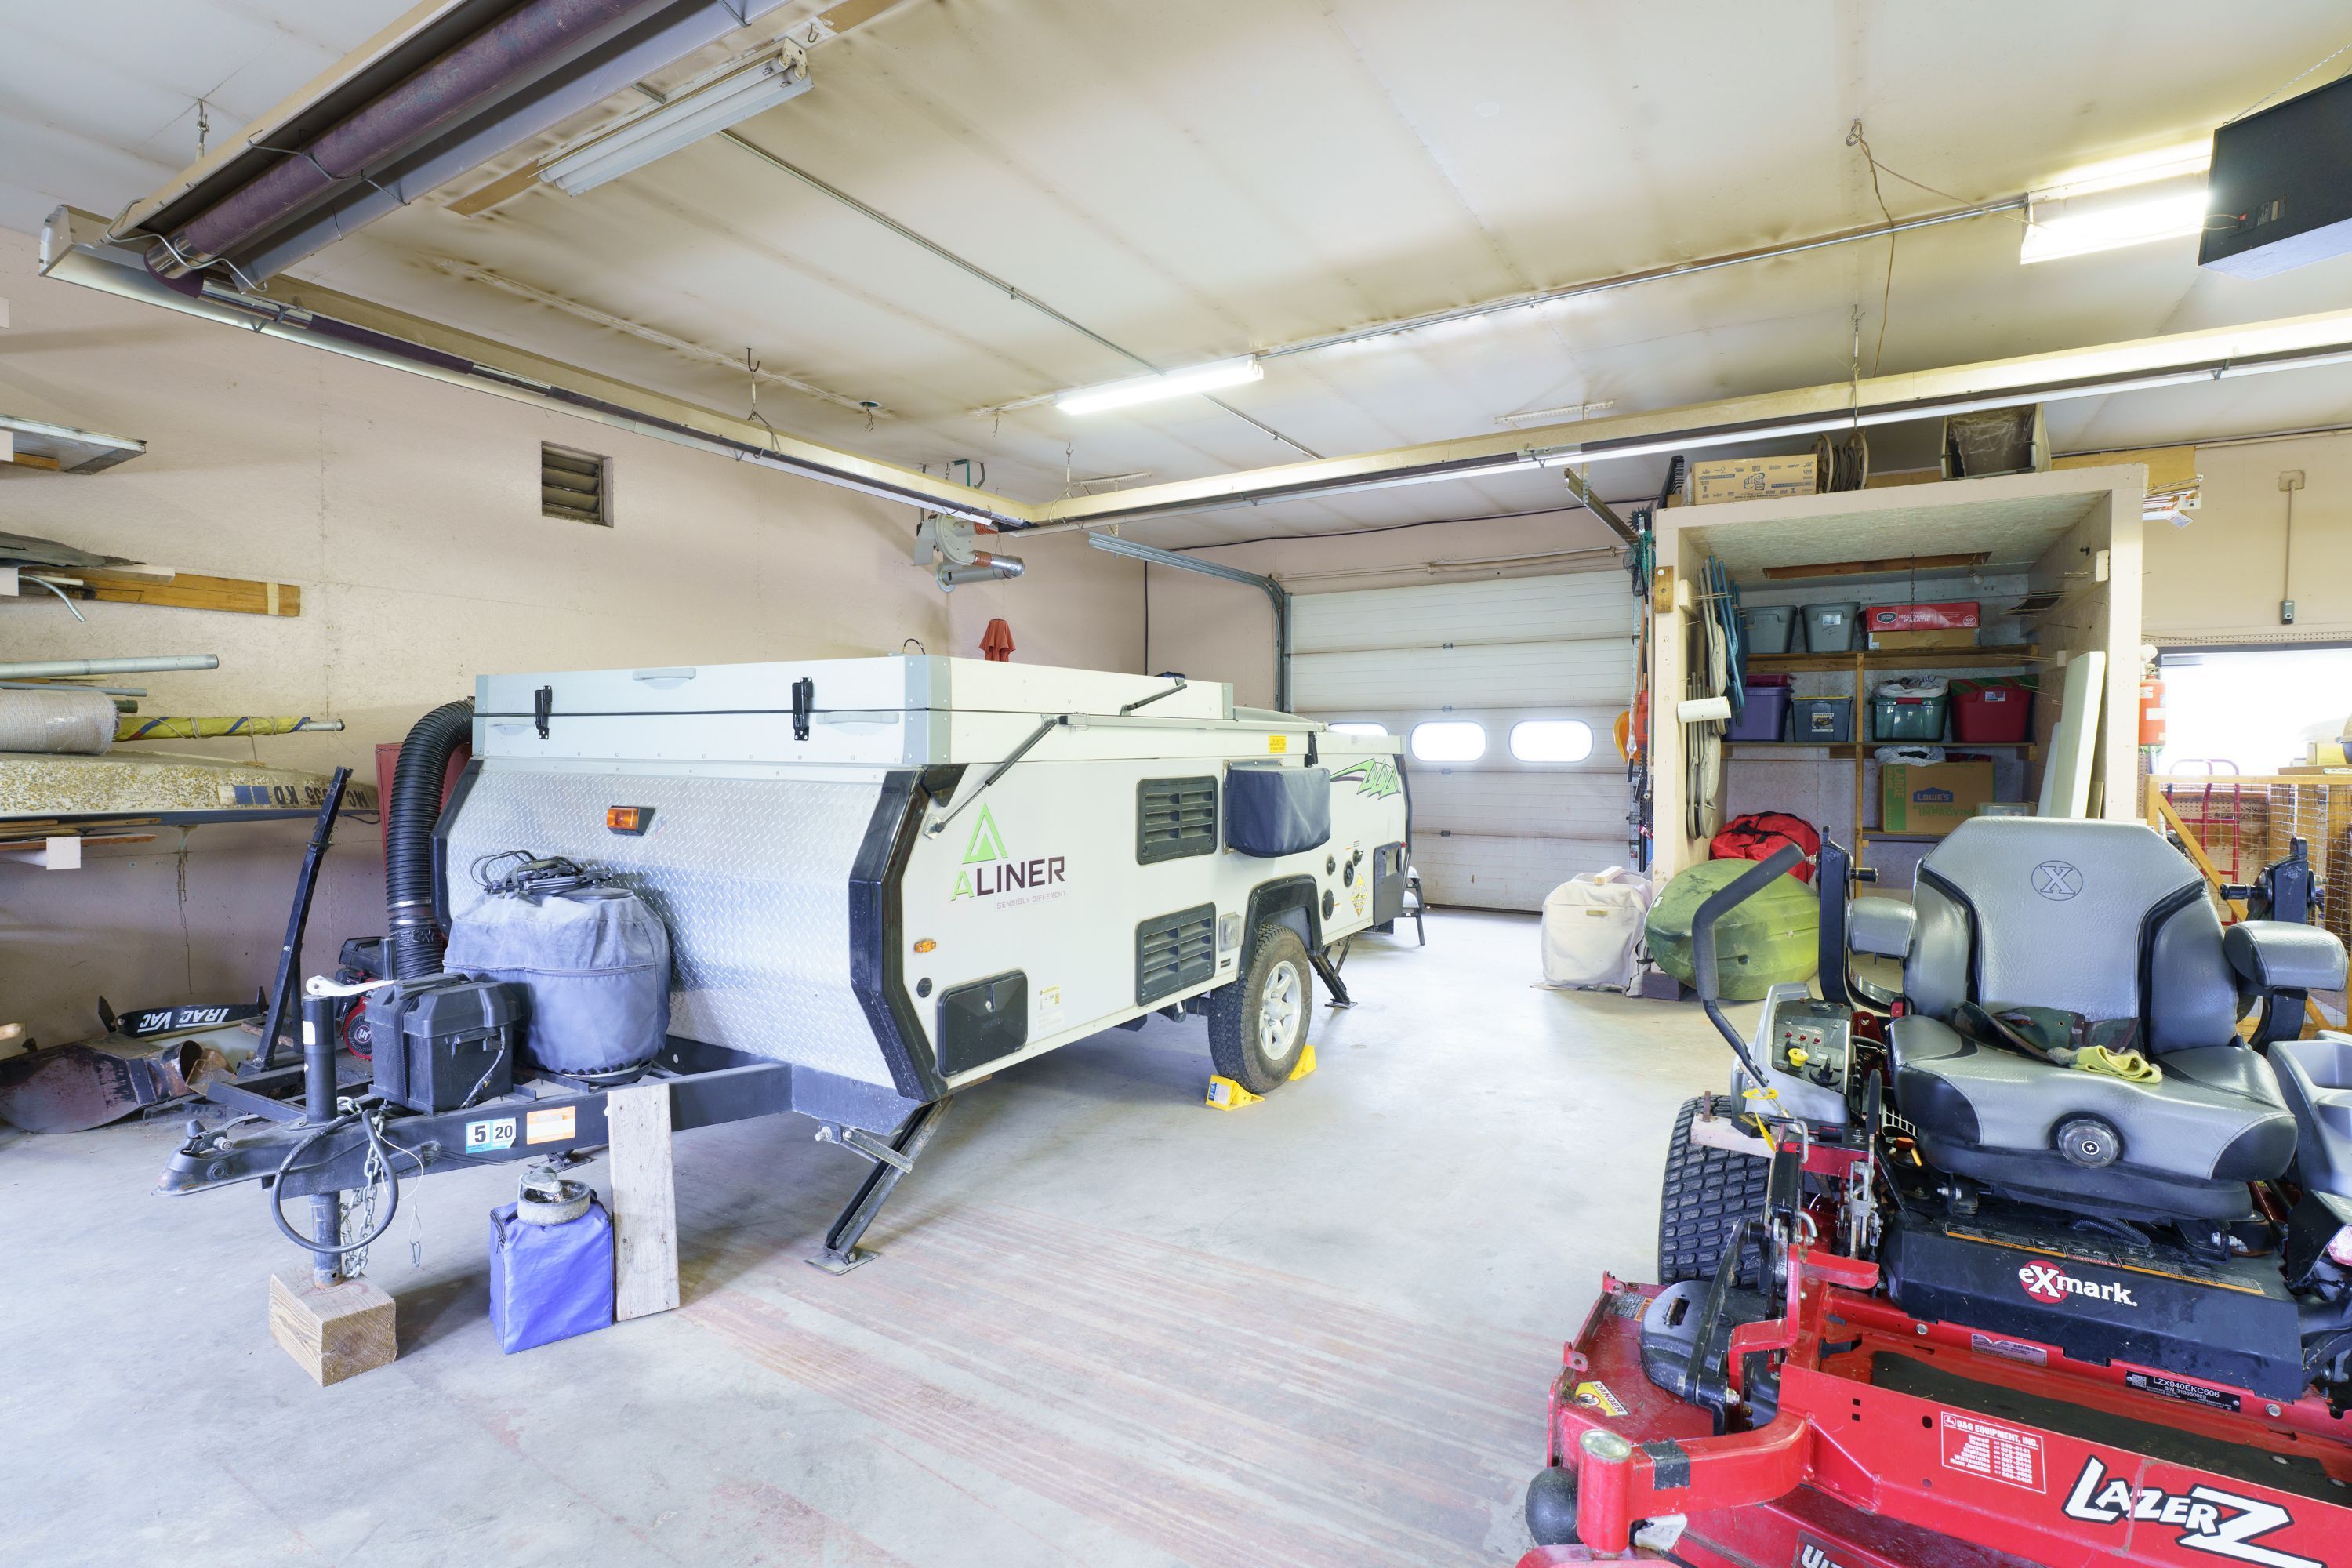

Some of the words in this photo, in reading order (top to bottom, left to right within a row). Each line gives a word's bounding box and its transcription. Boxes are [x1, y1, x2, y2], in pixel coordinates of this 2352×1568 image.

[1894, 766, 1904, 798] LARGE
[274, 785, 299, 805] KD
[348, 789, 370, 807] MC
[1918, 793, 1949, 801] LOWE'S
[951, 856, 1065, 901] ALINER
[996, 897, 1030, 909] SENSIBLY
[1033, 890, 1067, 902] DIFFERENT
[137, 1011, 172, 1033] VAC
[175, 1008, 230, 1028] TRAC
[474, 1125, 486, 1143] 5
[495, 1125, 513, 1139] 20
[1595, 1383, 1624, 1413] DANGER
[2153, 1377, 2220, 1398] LZX940EKC606
[1956, 1420, 1973, 1431] D&G
[1975, 1424, 2020, 1444] EQUIPMENT,
[2022, 1436, 2039, 1448] INC.
[2064, 1456, 2220, 1535] LAZER
[2176, 1486, 2324, 1568] Z
